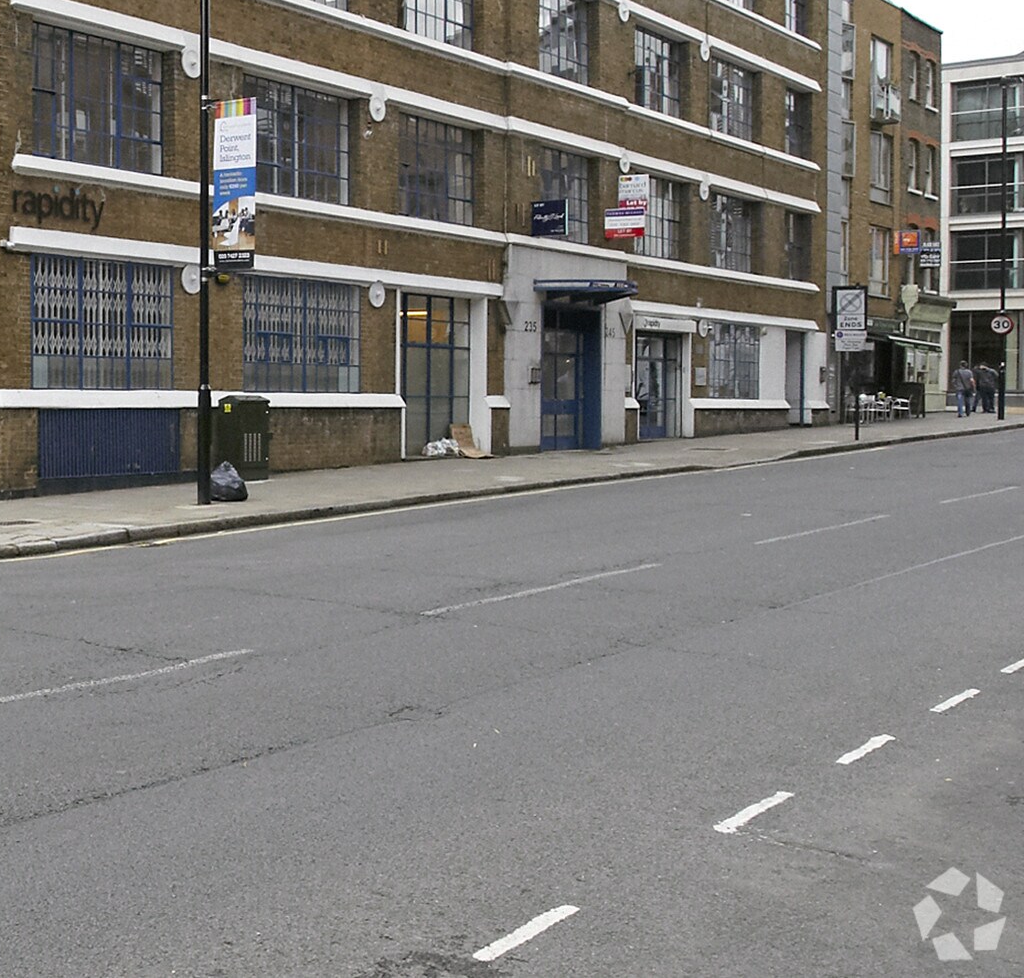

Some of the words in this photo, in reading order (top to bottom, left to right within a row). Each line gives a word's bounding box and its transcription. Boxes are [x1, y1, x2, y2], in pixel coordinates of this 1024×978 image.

[219, 133, 251, 143] Derwent
[219, 153, 252, 163] Islington
[12, 185, 105, 230] rapidity
[524, 321, 537, 333] 235
[993, 320, 1010, 329] 30
